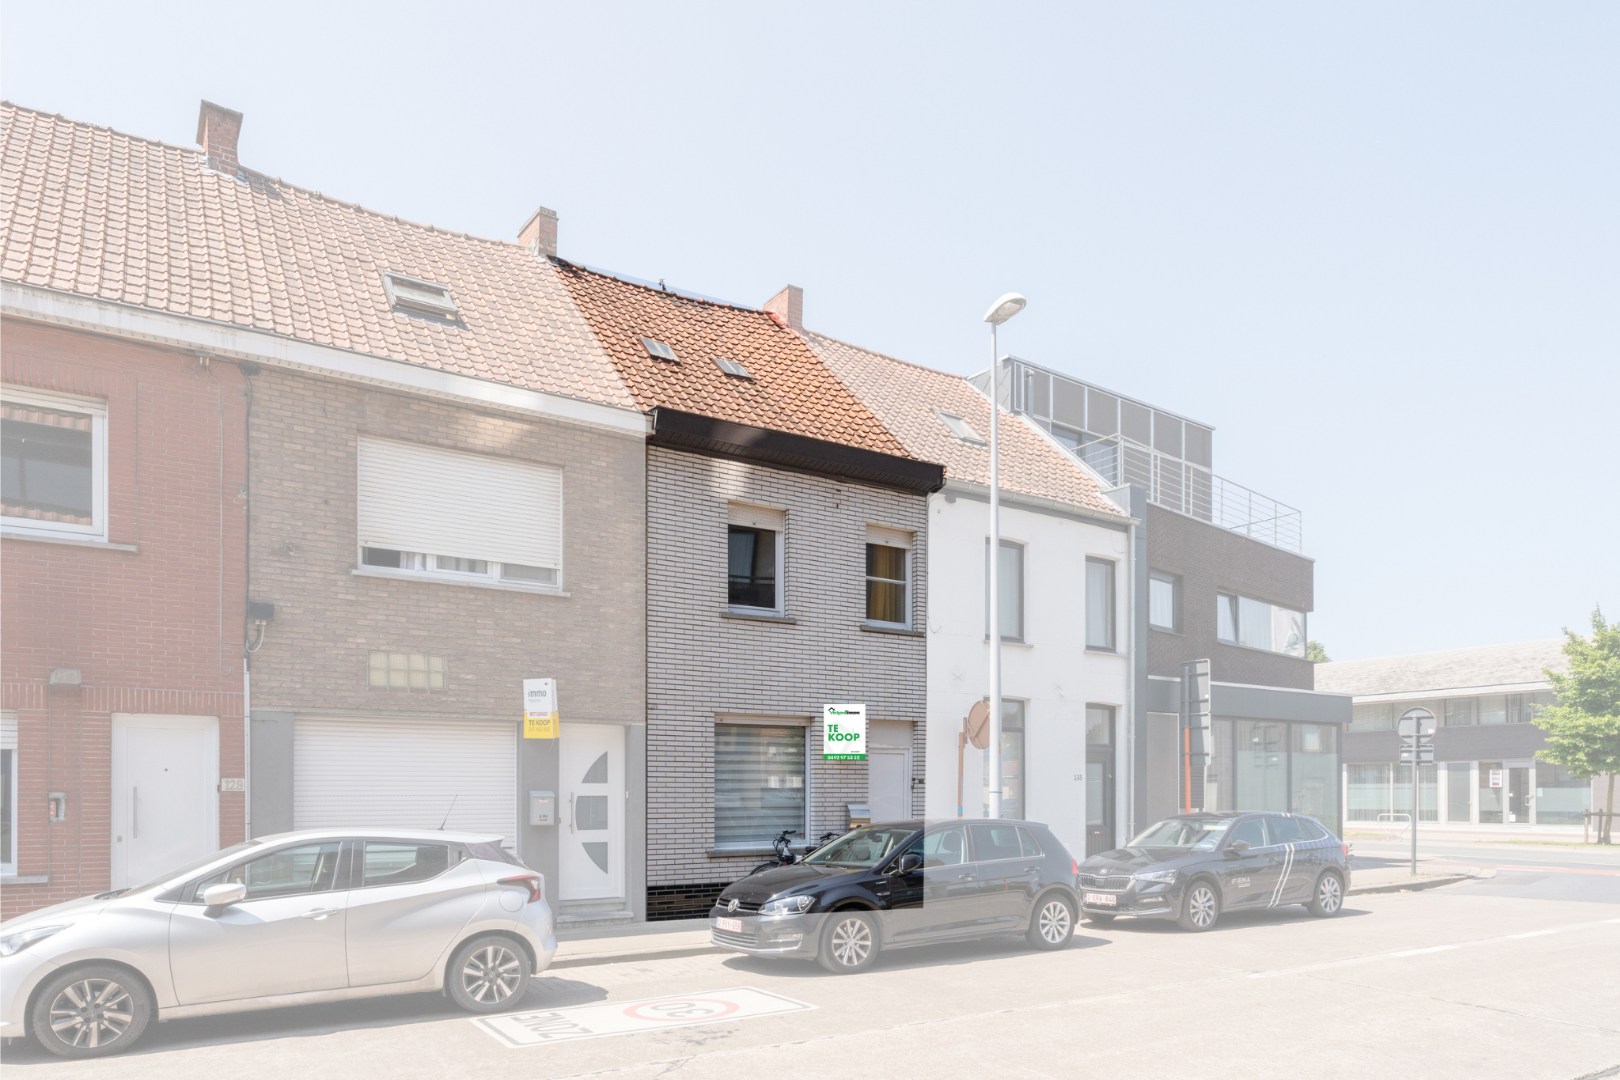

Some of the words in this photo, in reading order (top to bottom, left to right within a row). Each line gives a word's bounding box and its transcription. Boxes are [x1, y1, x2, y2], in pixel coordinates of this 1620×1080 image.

[827, 724, 839, 733] TE
[828, 733, 860, 741] KOOP
[649, 1001, 714, 1018] 30
[510, 1010, 594, 1039] ZONE
